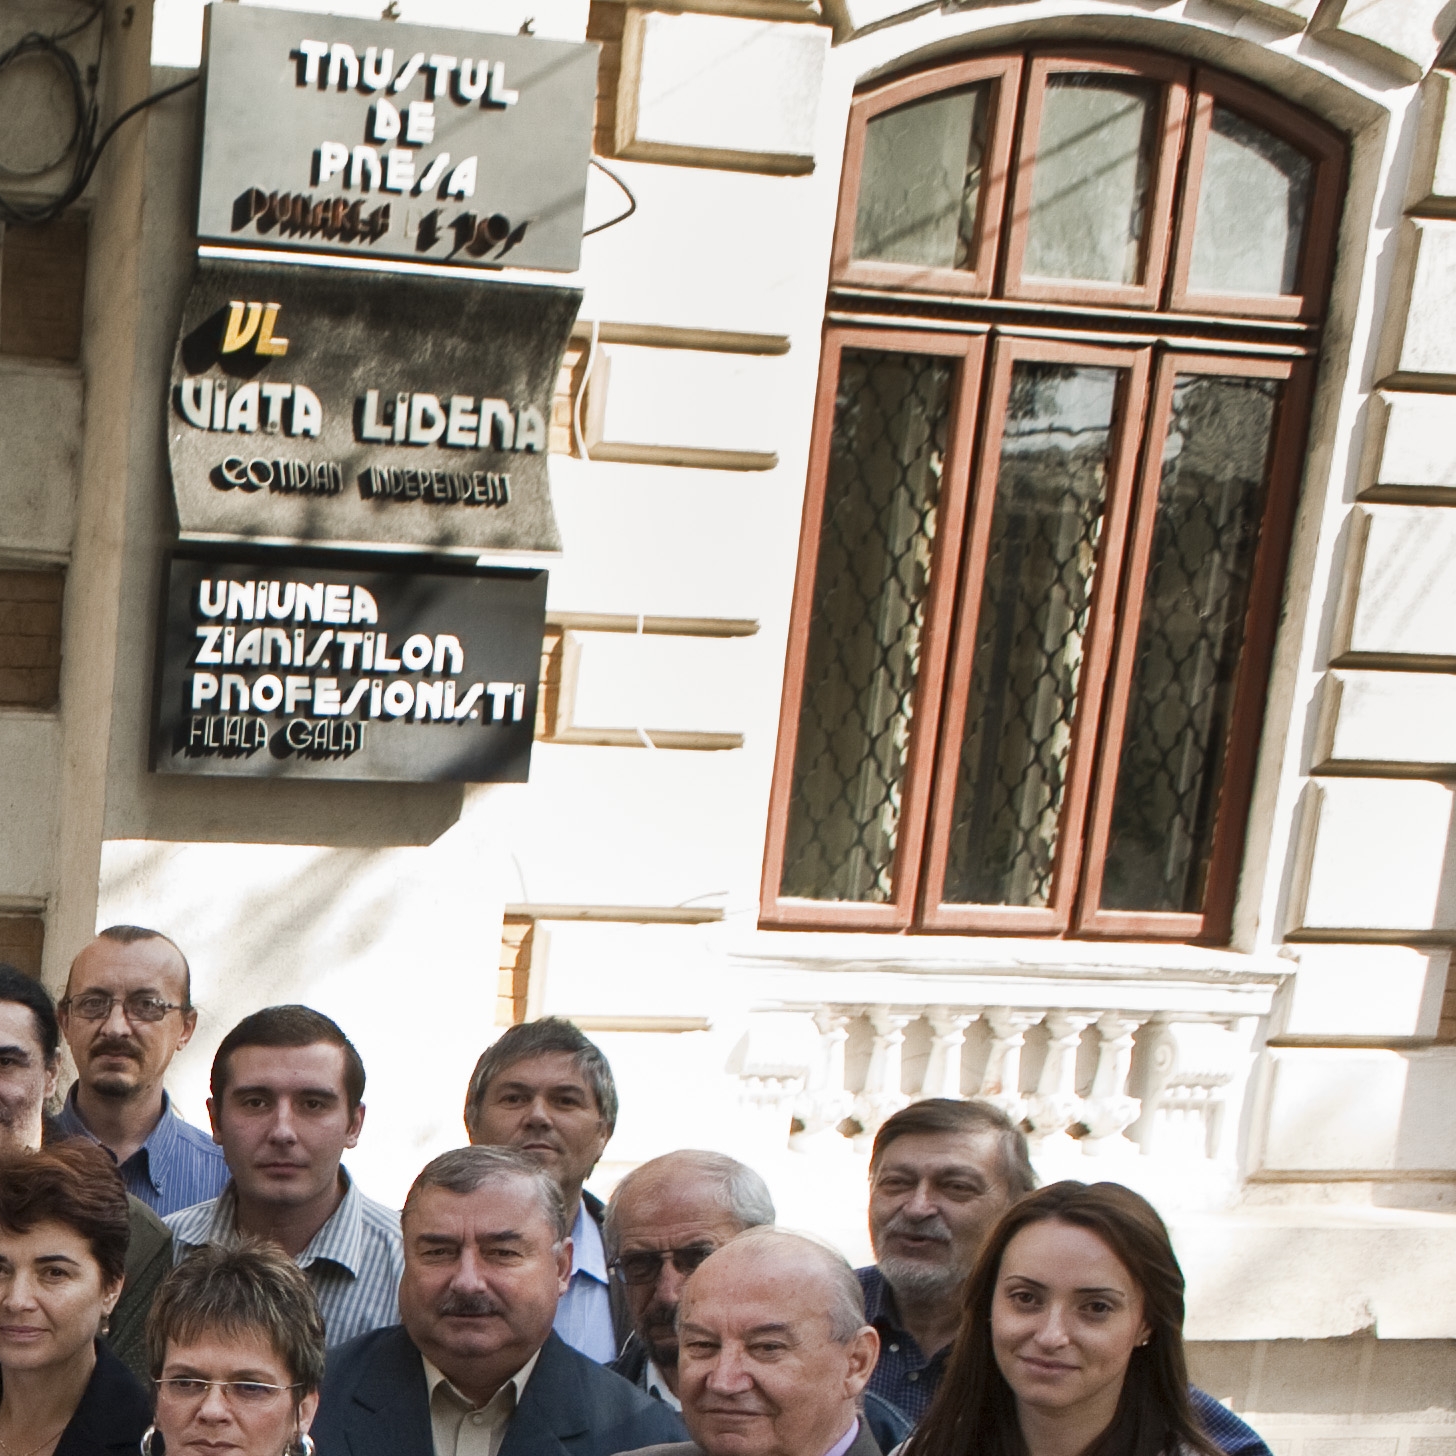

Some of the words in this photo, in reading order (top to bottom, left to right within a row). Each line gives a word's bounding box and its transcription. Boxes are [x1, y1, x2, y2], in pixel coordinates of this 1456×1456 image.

[300, 39, 519, 105] TRUSTUL
[374, 97, 436, 144] DE
[319, 141, 478, 197] PRESA
[222, 300, 289, 355] VL
[222, 455, 344, 493] COTIDIAN
[370, 465, 512, 502] INDEPENDENT
[199, 579, 378, 624] UNIUNEA
[190, 716, 268, 748] FILIALA
